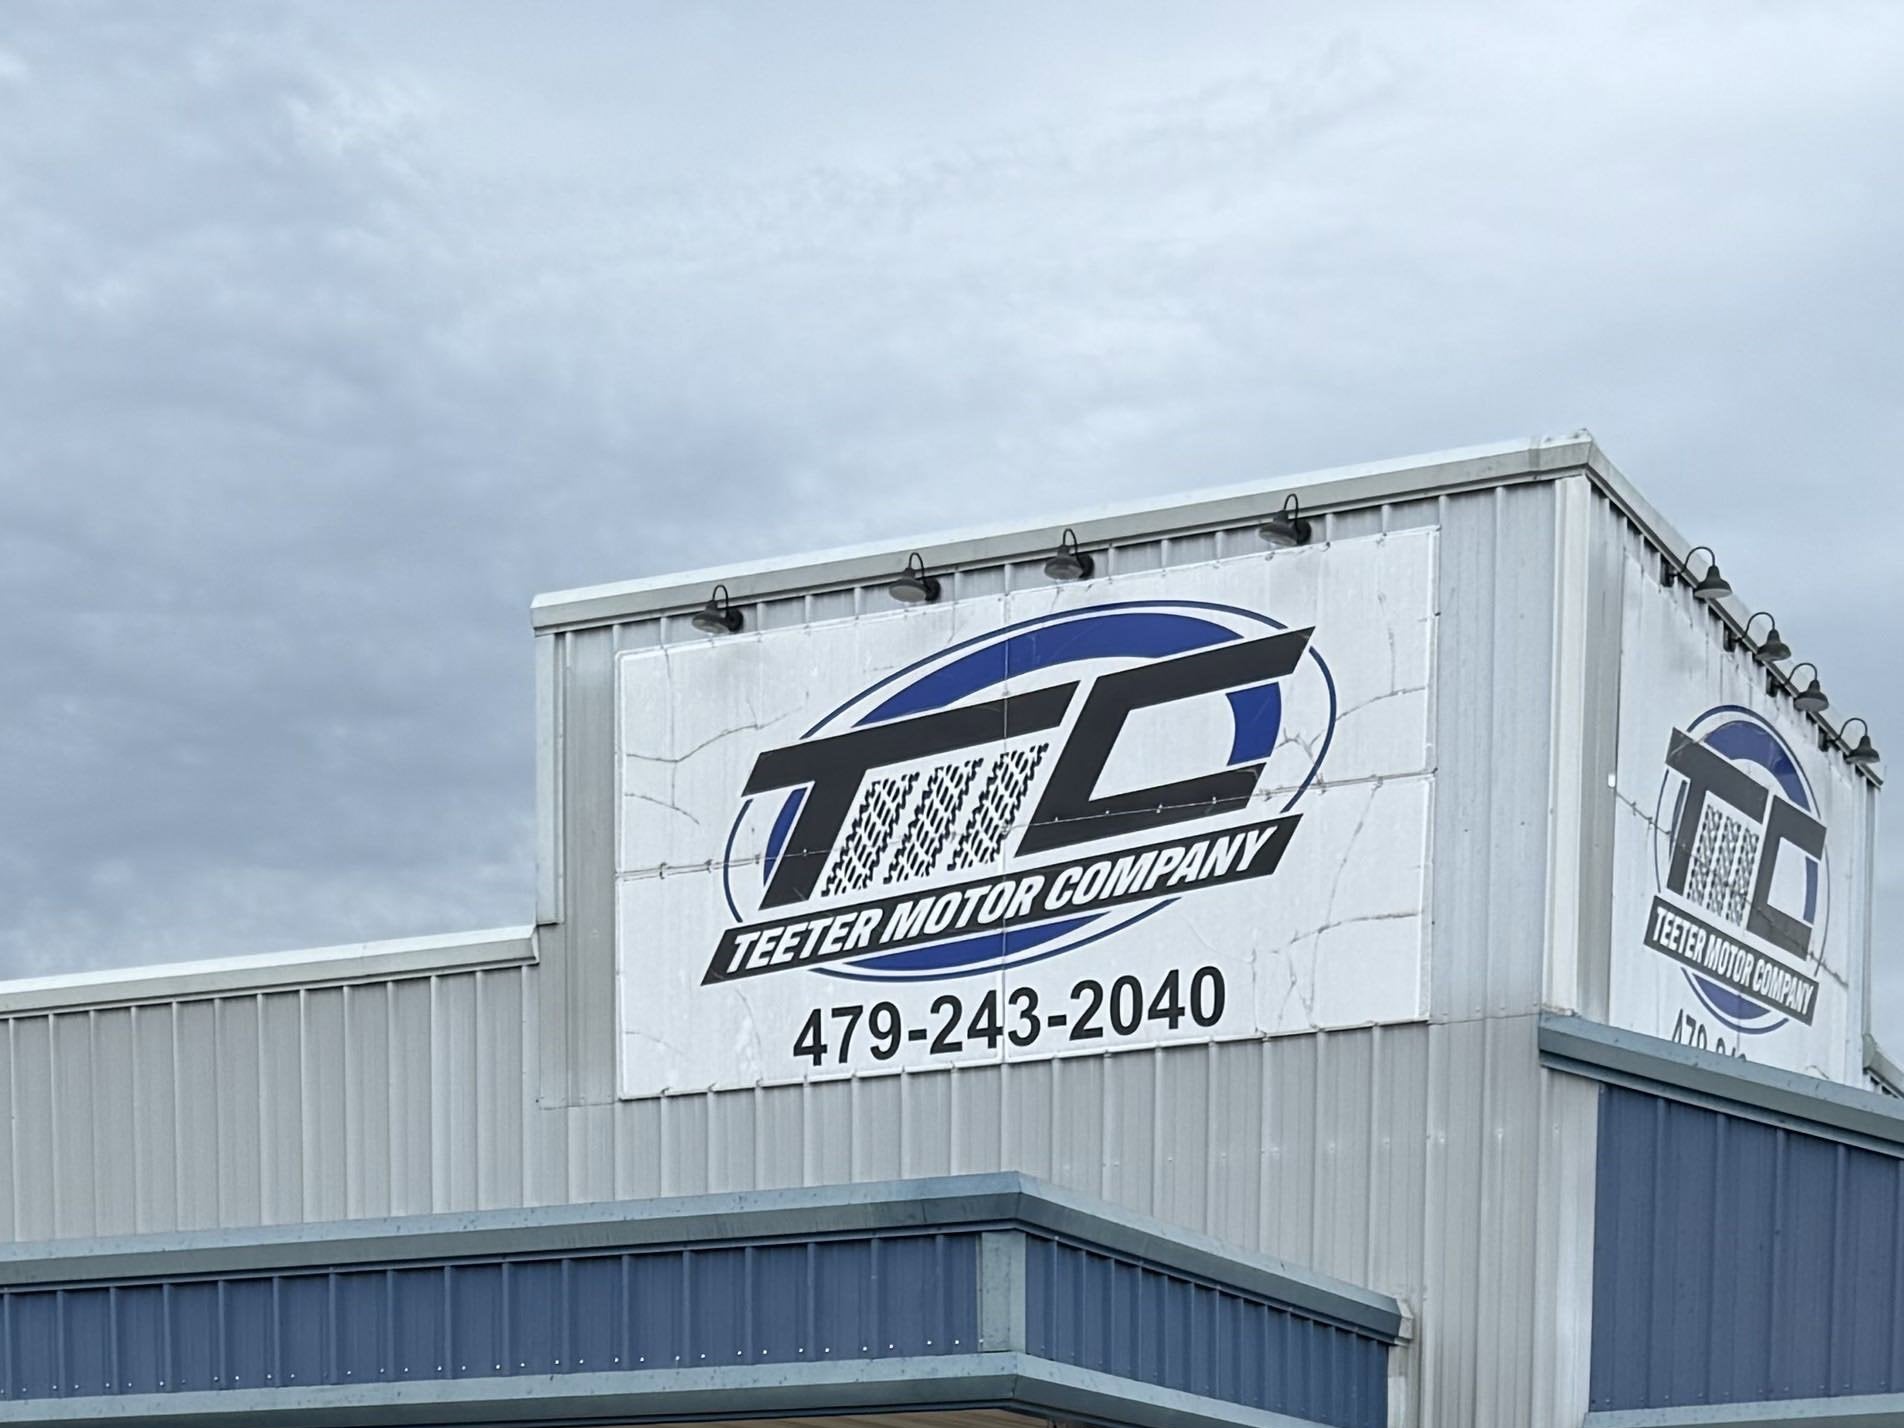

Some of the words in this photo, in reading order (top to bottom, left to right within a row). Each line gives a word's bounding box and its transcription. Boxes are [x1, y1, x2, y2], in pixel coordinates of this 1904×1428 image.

[726, 908, 881, 975] TEETER
[880, 877, 1040, 943] MOTOR
[1044, 827, 1277, 909] COMPANY
[792, 965, 1226, 1066] 479-243-2040
[1652, 907, 1704, 963] TEETER
[1705, 934, 1753, 987] MOTOR
[1753, 958, 1814, 1016] COMPANY
